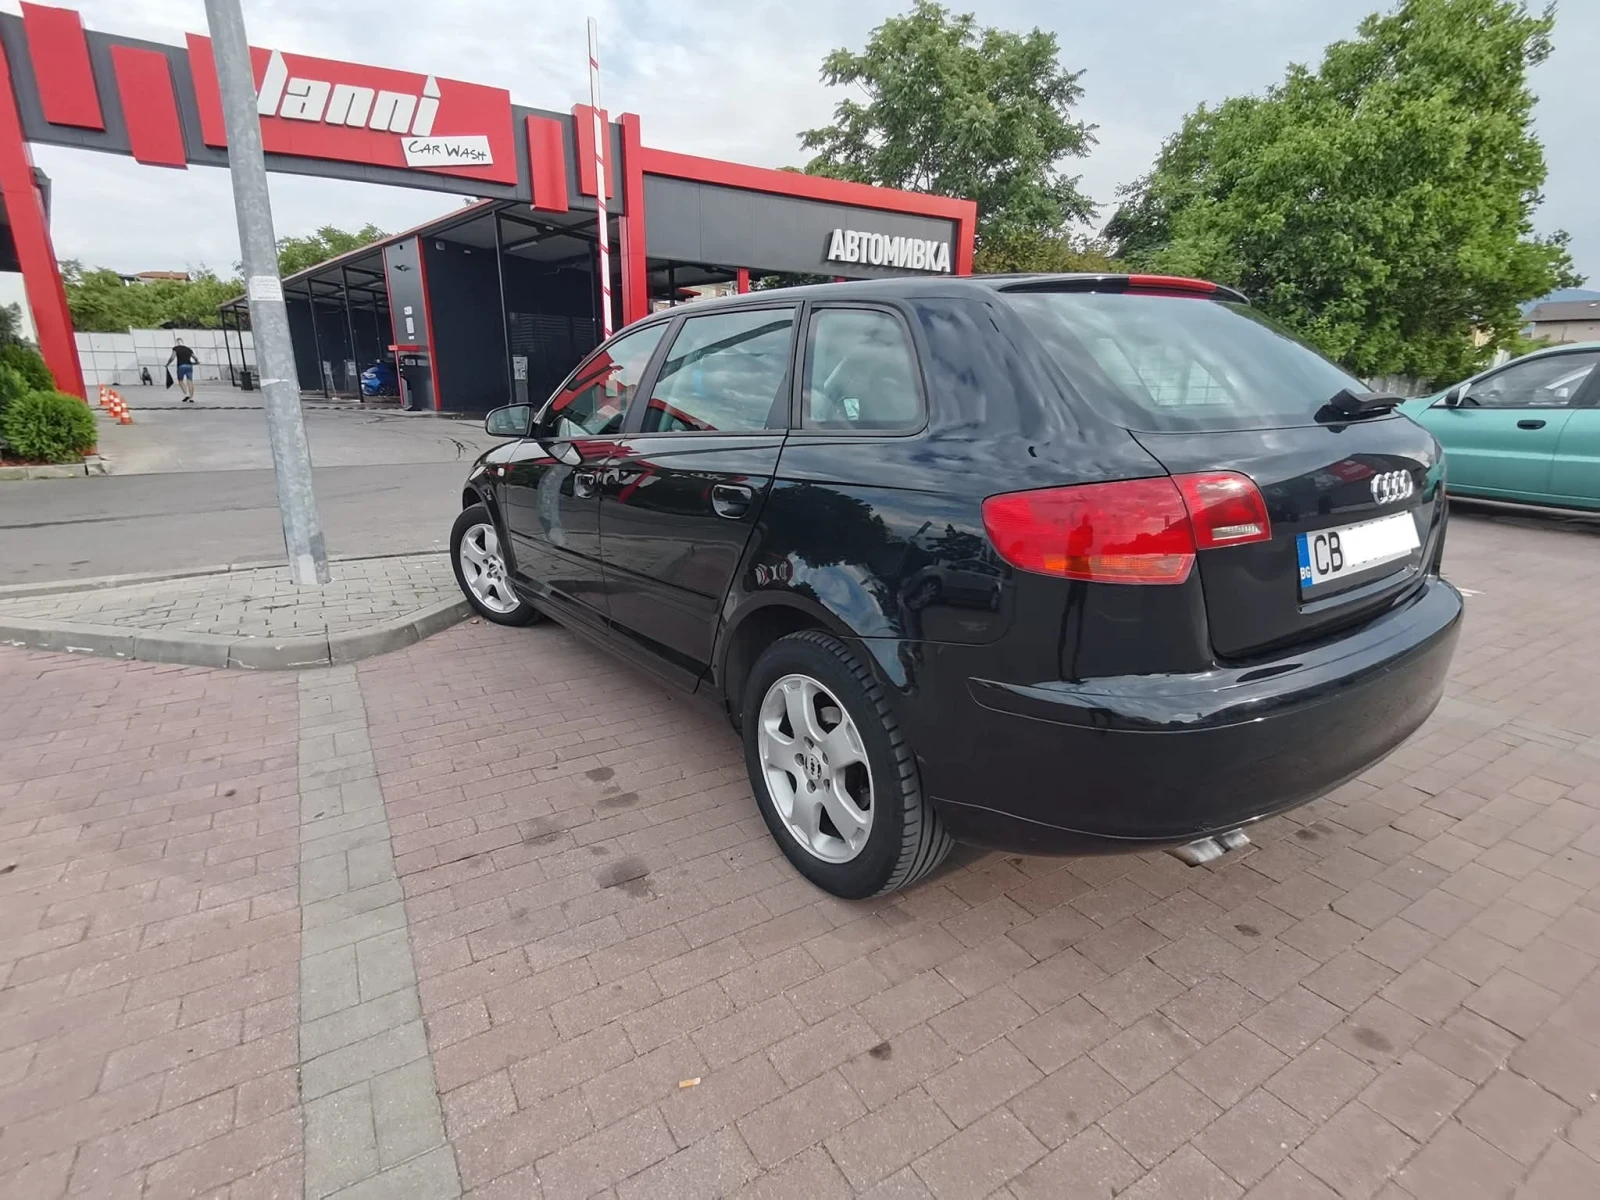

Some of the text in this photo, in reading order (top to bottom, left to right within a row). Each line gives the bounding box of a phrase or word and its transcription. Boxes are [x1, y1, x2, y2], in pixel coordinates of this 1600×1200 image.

[254, 48, 441, 137] lanni
[408, 140, 487, 161] CAR WASH
[827, 228, 951, 273] АВТОМИВКА
[1300, 566, 1311, 580] BG
